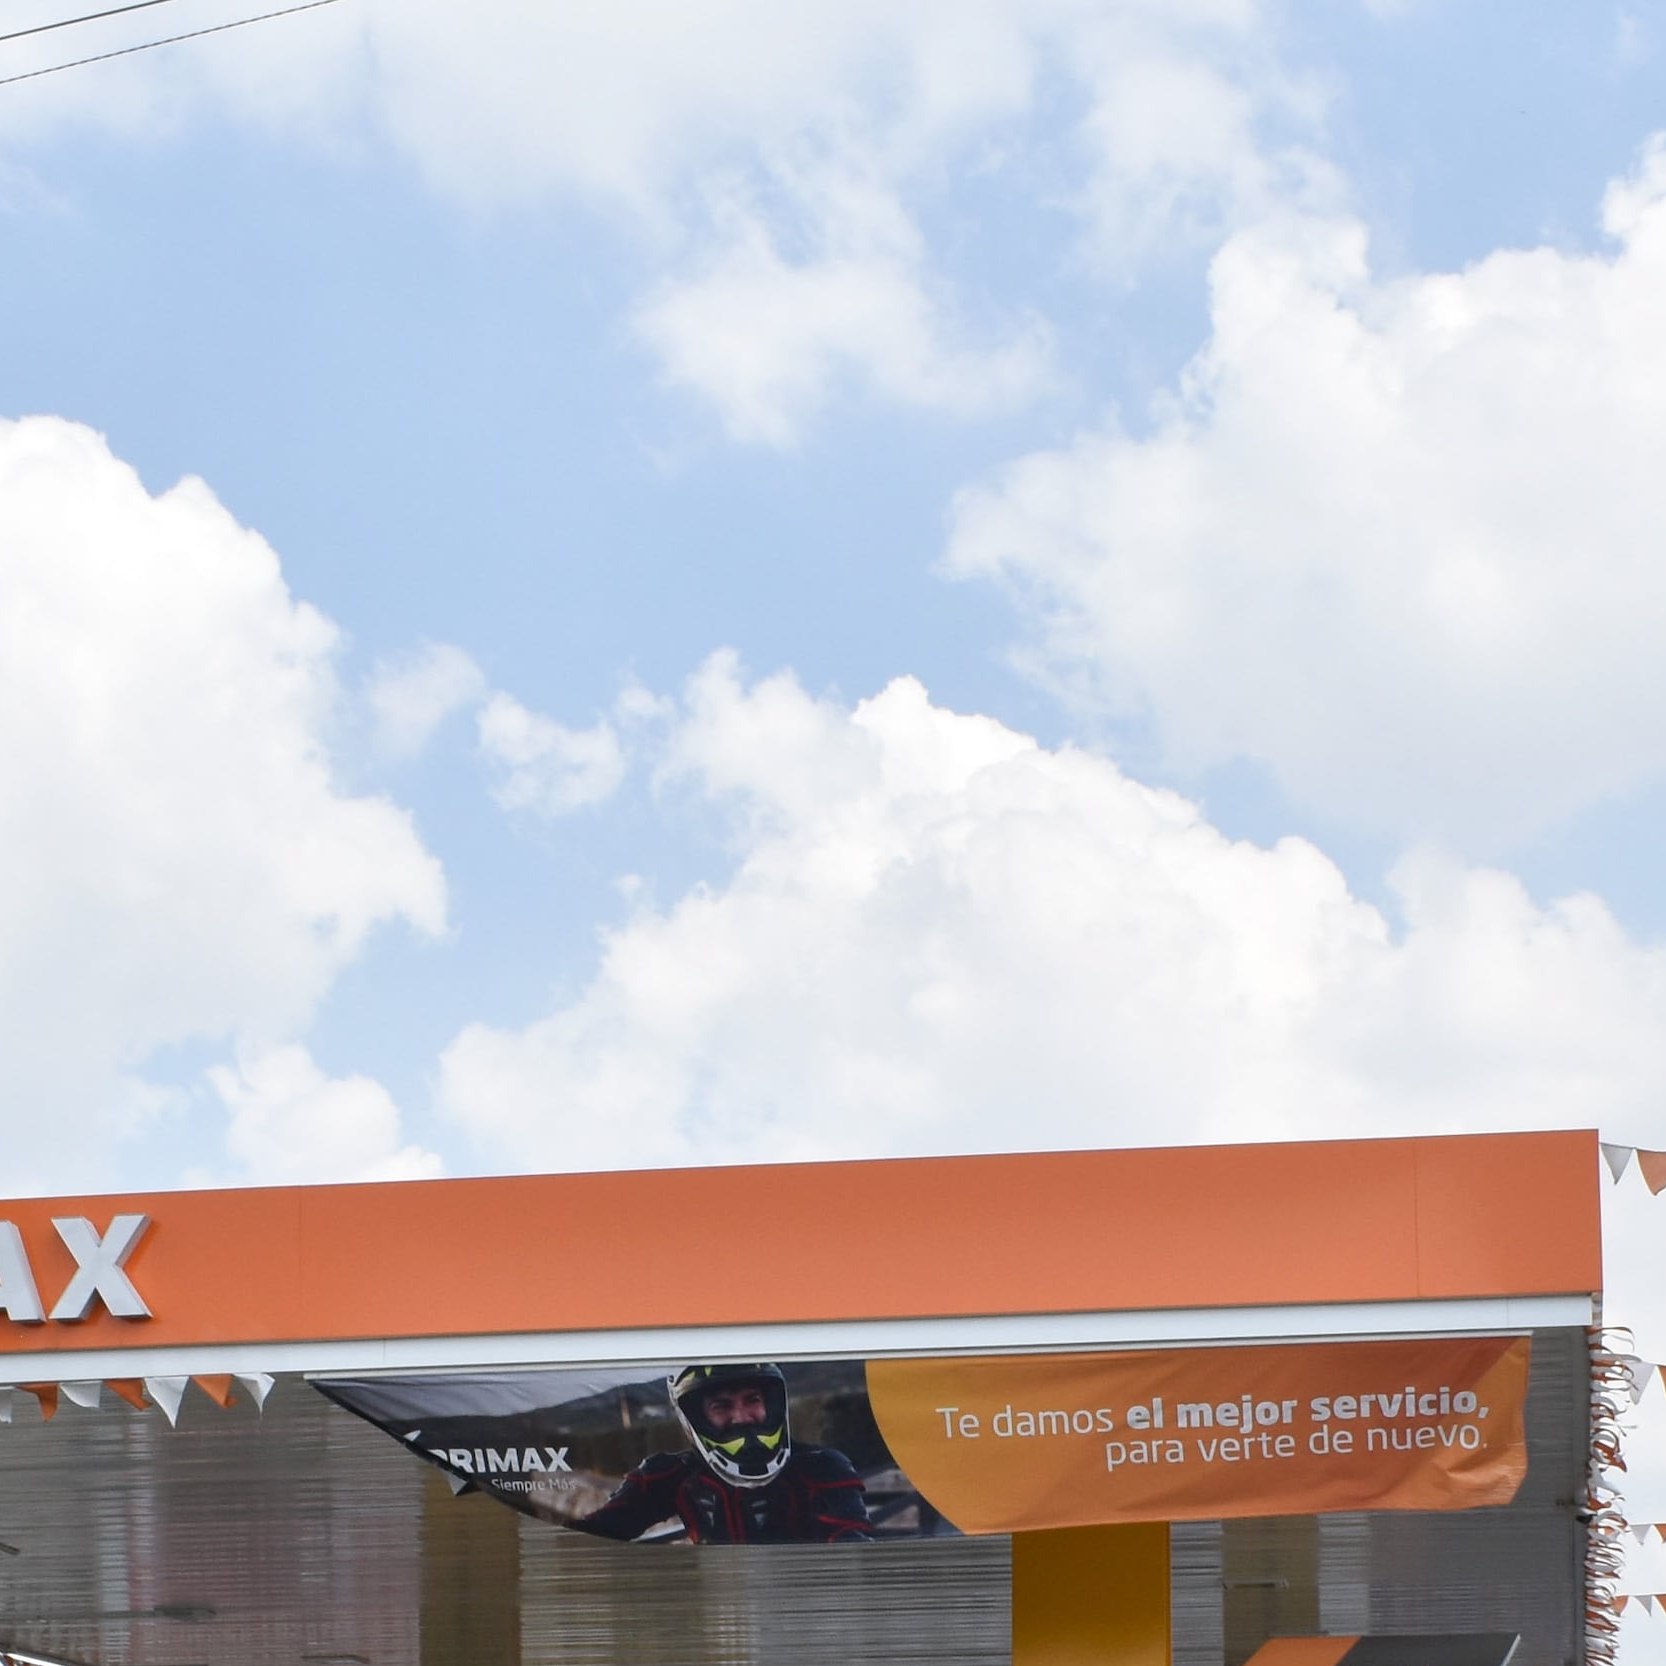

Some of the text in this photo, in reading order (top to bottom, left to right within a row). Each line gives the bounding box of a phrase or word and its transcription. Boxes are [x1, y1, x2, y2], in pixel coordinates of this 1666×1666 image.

[936, 1386, 1489, 1439] Te damos el mejor servicio,
[1105, 1423, 1488, 1472] para verte de nuevo.
